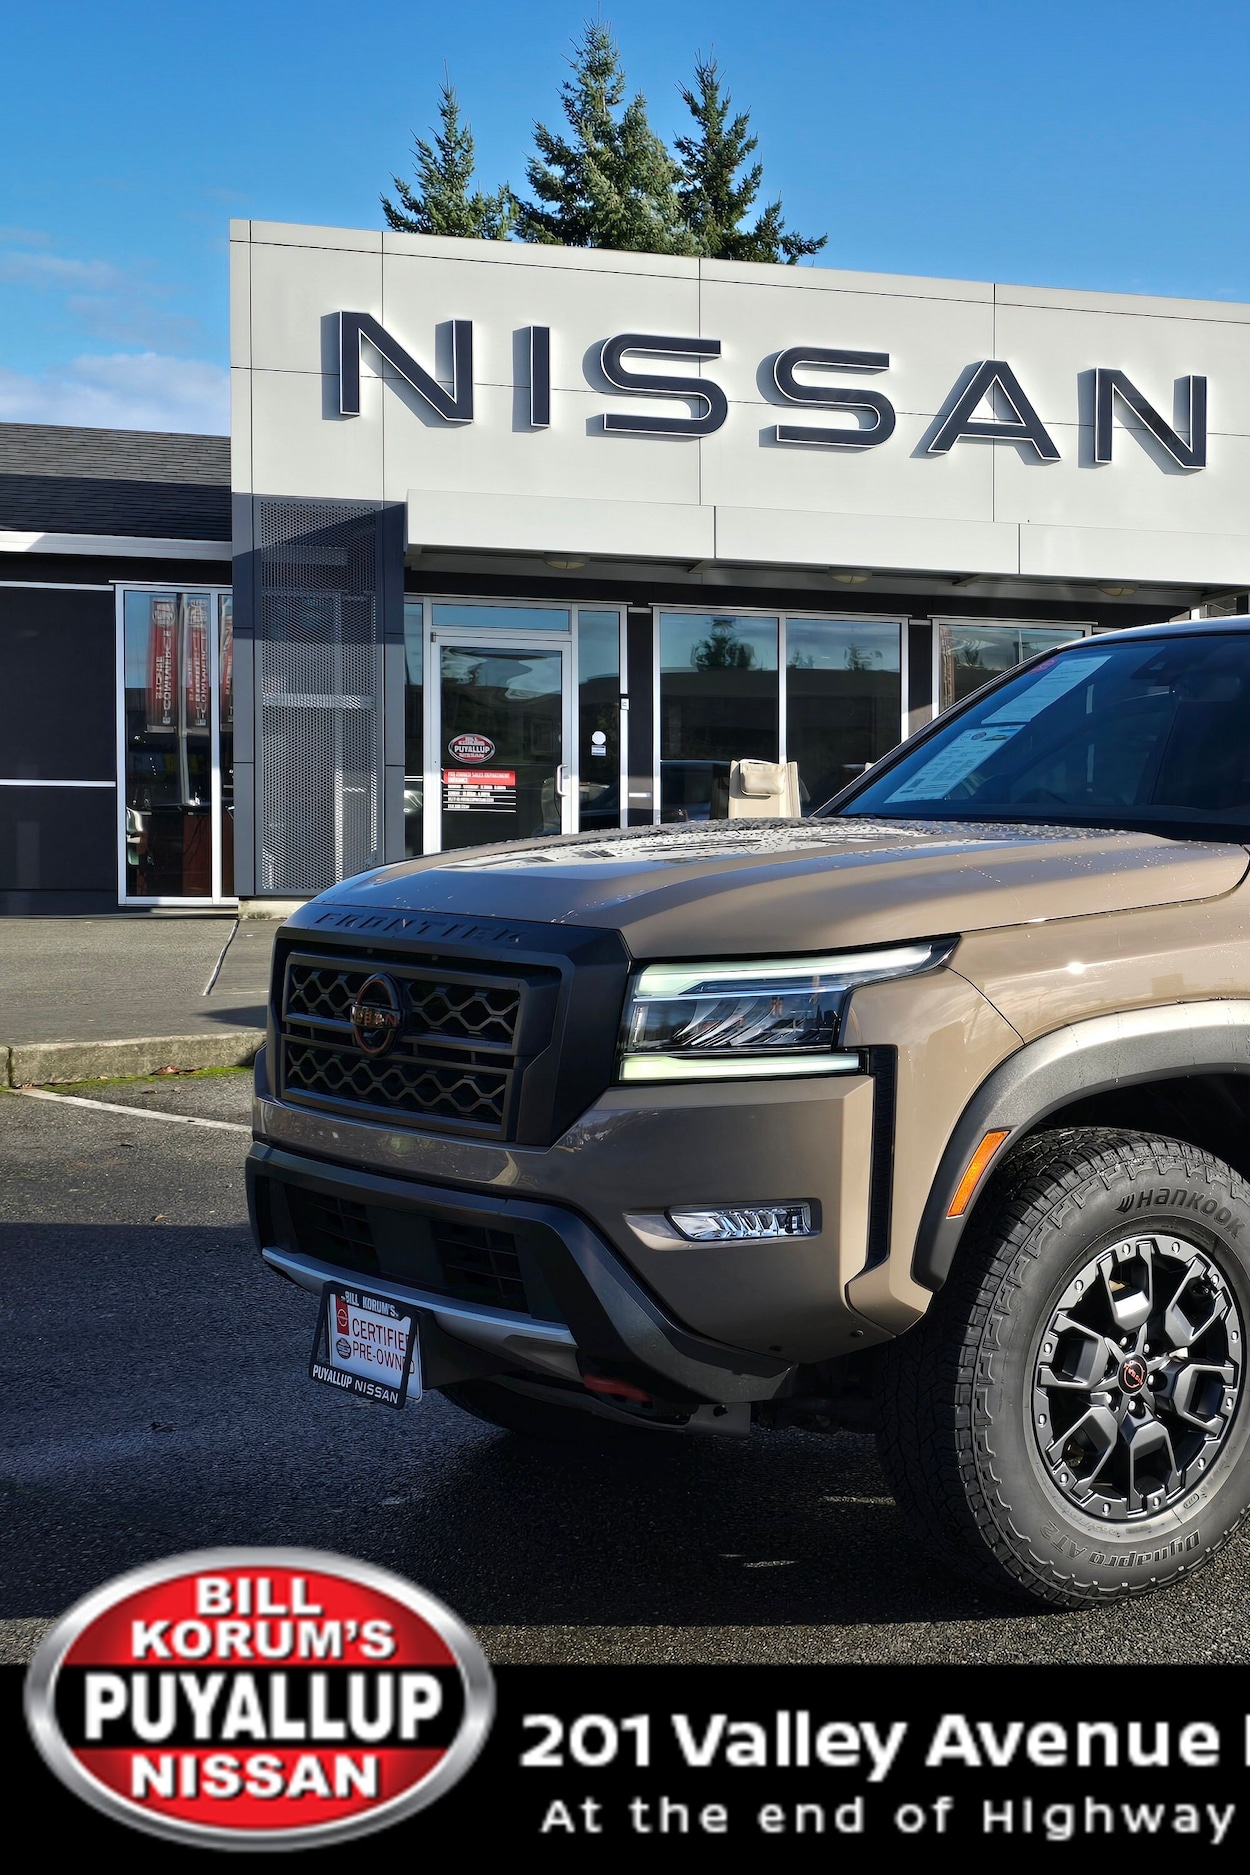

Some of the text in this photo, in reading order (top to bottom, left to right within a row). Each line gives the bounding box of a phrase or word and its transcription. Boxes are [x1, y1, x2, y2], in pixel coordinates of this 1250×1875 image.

[336, 311, 1208, 470] NISSAN
[314, 911, 529, 945] FRONTIER
[362, 1295, 398, 1318] KORUM'S
[312, 1364, 399, 1405] PUYALLUP NISSAN
[1088, 1529, 1201, 1569] Dynapro
